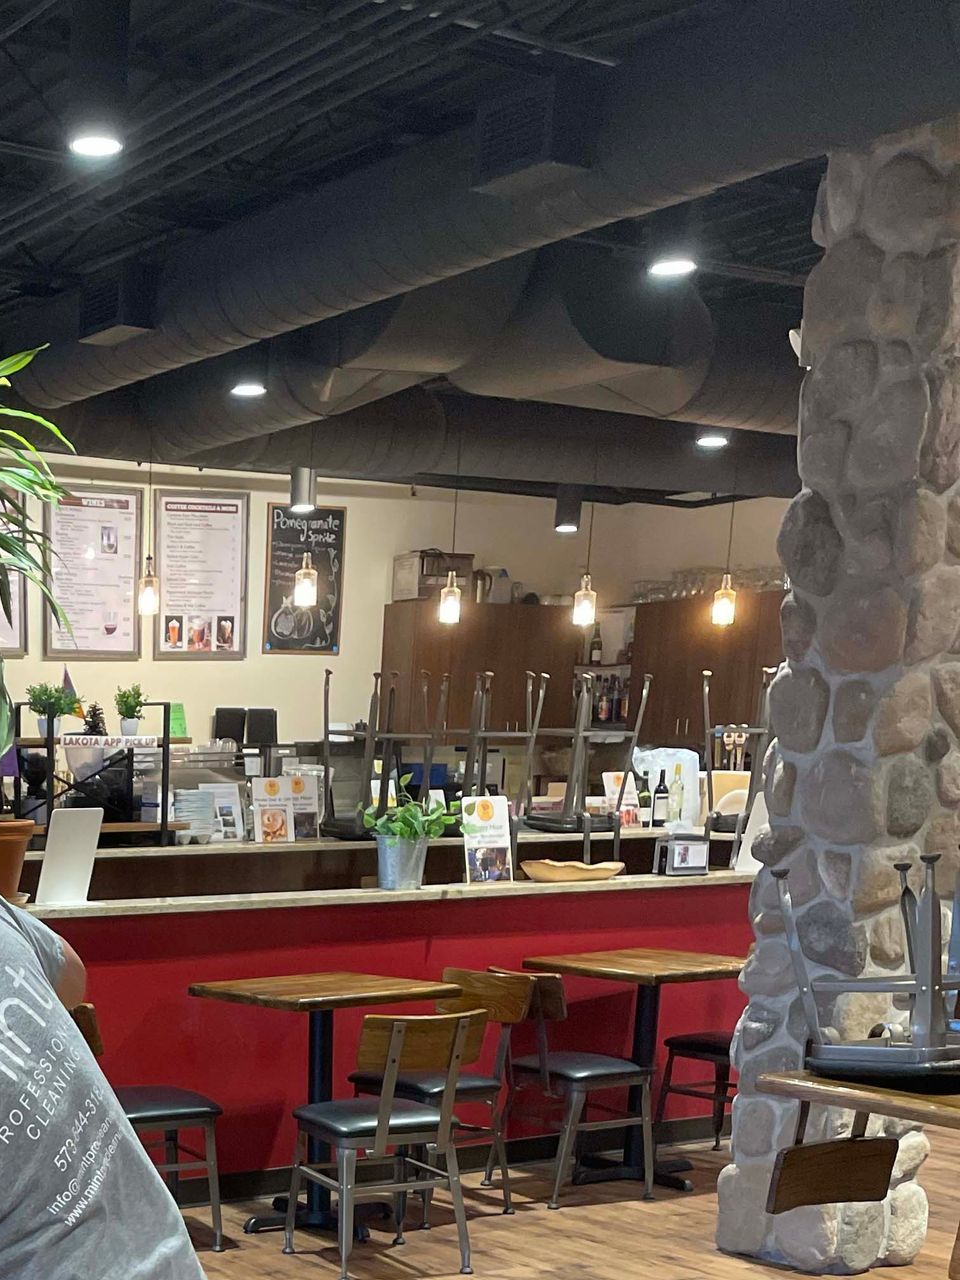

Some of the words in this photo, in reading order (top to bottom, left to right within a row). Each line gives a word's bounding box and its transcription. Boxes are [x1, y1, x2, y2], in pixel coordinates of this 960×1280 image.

[273, 509, 340, 541] Pomegranate
[62, 737, 100, 747] LAKOTA
[103, 739, 122, 747] APP
[124, 739, 144, 748] PICK
[145, 739, 157, 747] UP
[25, 1047, 81, 1141] CLEANING
